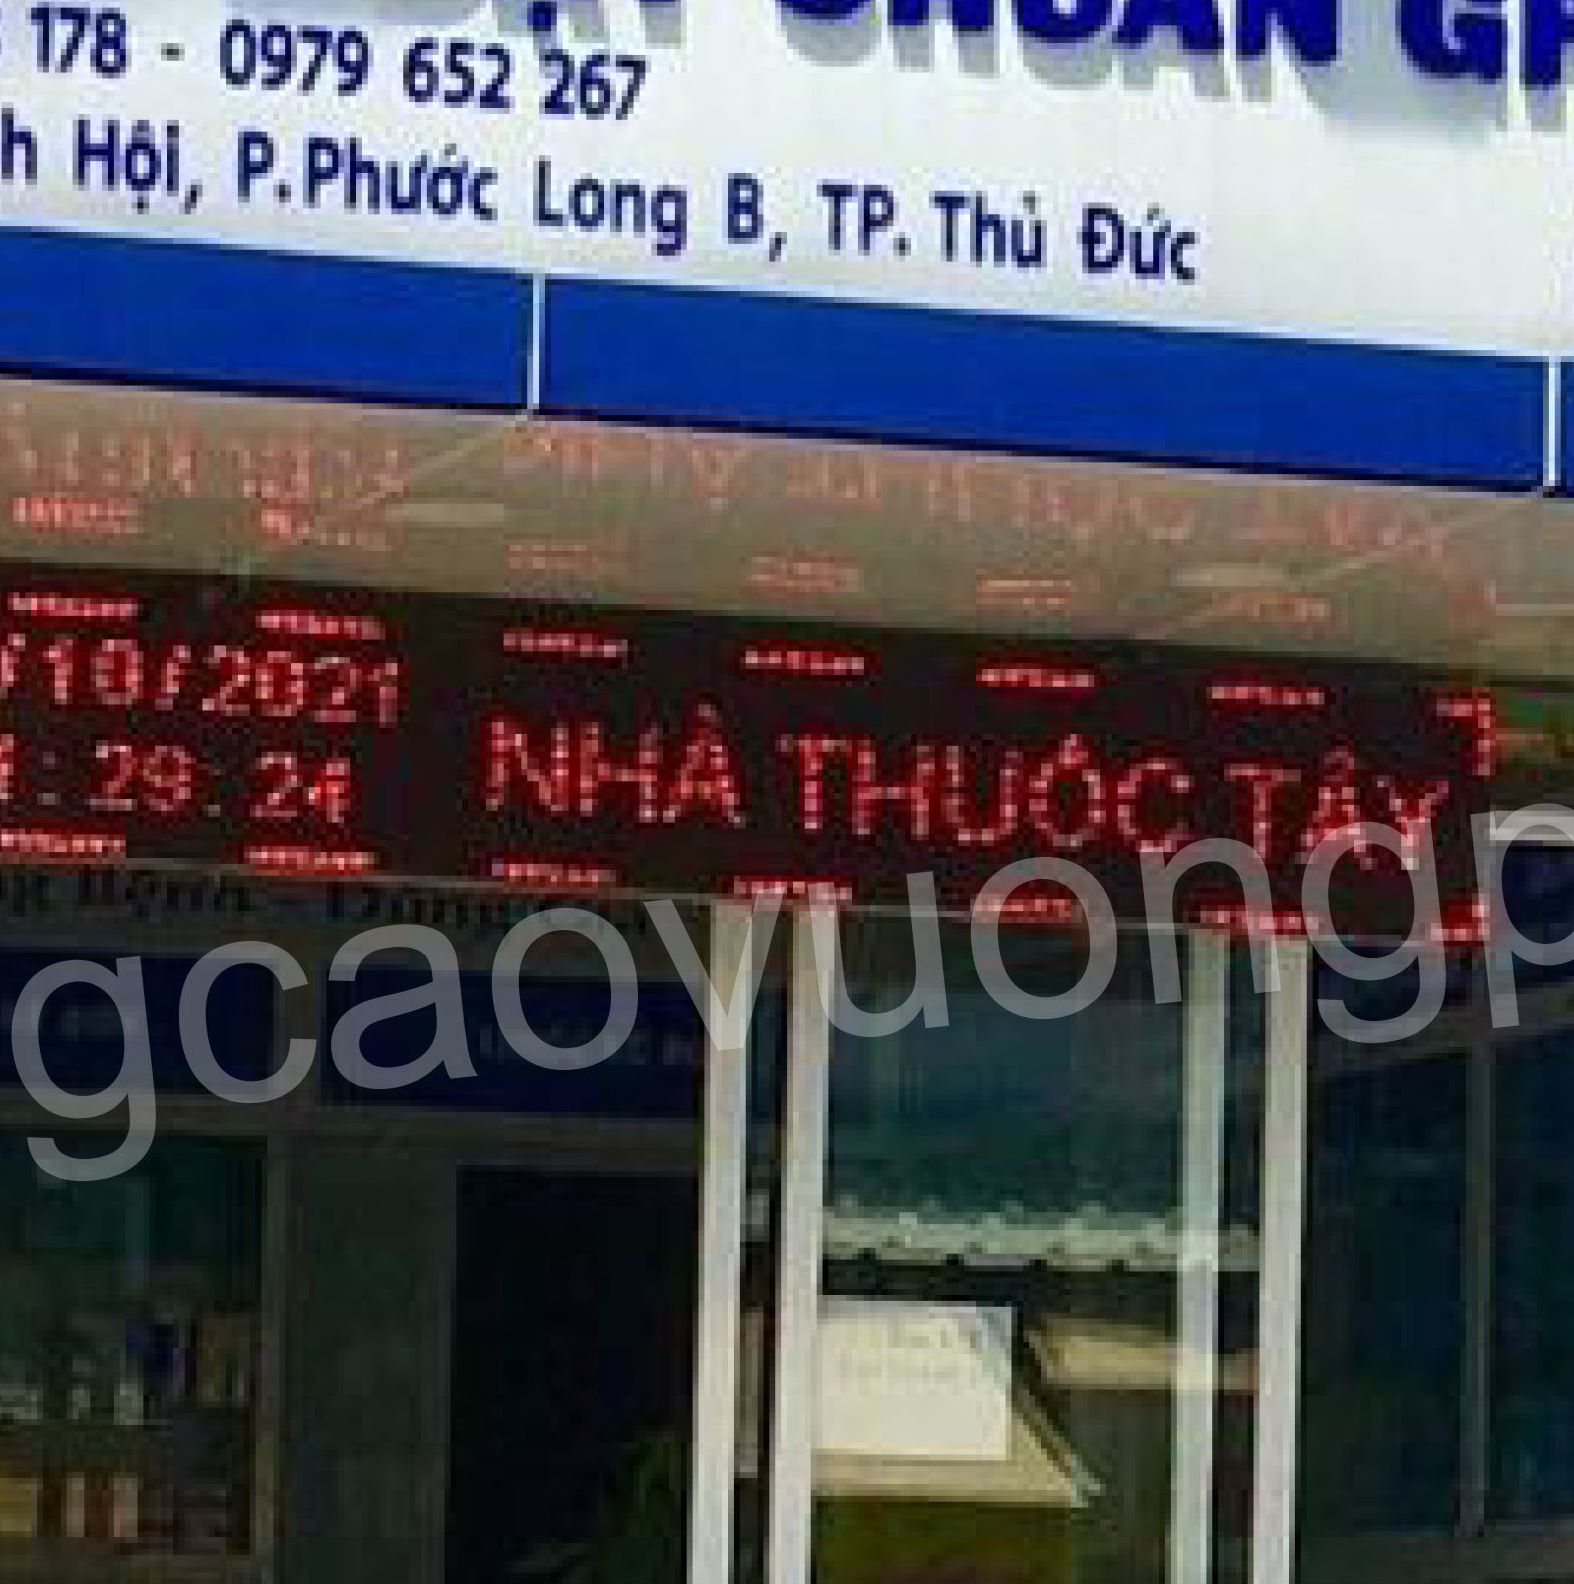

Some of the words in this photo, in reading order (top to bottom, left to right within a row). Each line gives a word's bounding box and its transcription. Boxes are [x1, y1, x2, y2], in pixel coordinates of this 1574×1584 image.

[30, 2, 130, 77] 178
[219, 19, 371, 99] 0979
[401, 36, 513, 114] 652
[538, 48, 648, 124] 267
[74, 116, 204, 217] Hội,
[533, 157, 689, 257] Long
[724, 173, 787, 264] B,
[1079, 203, 1197, 282] Đức
[483, 701, 749, 827] NHÀ
[1224, 746, 1448, 872] TÂY
